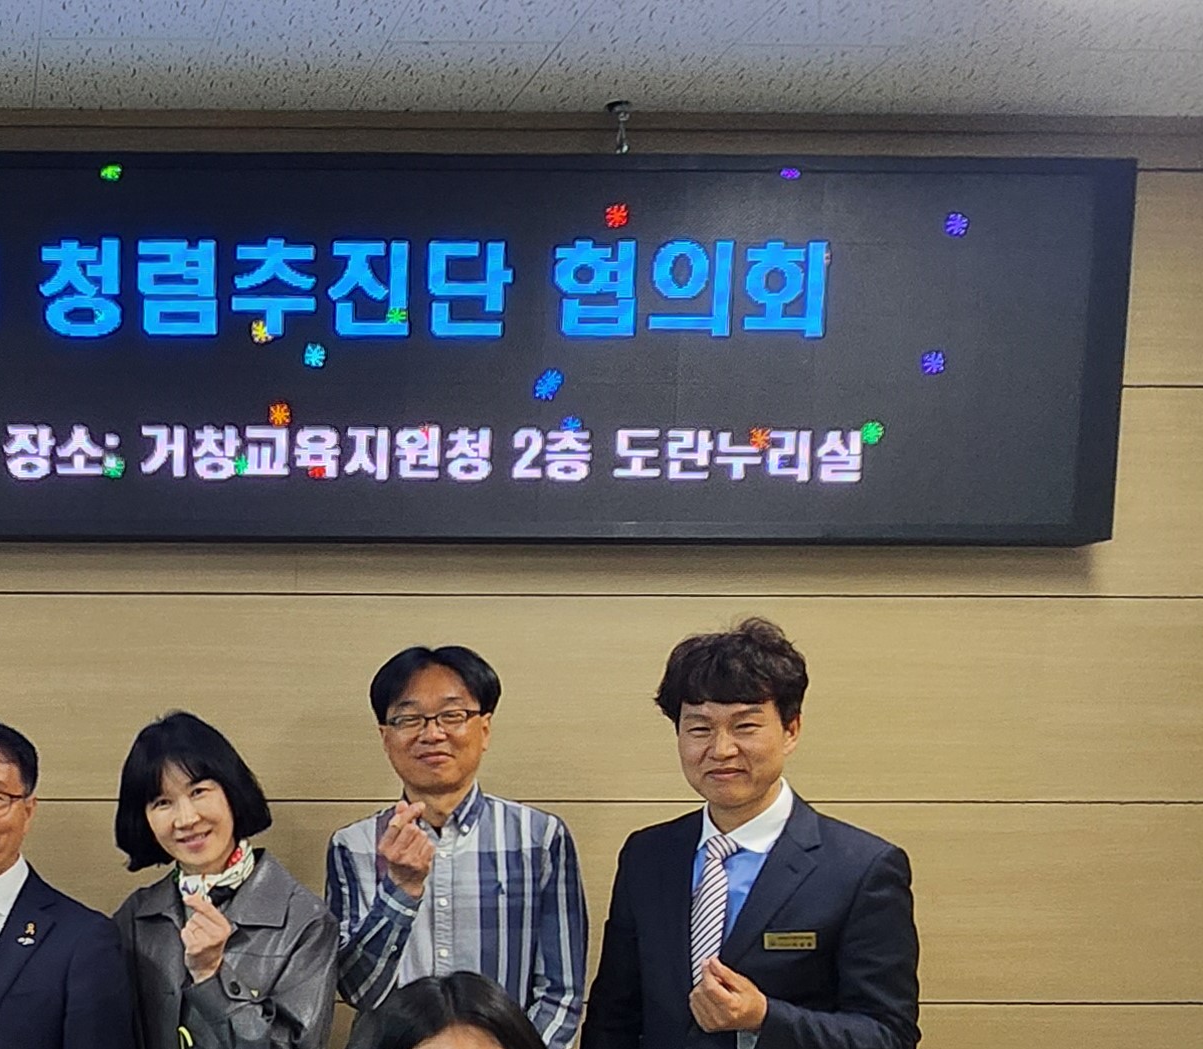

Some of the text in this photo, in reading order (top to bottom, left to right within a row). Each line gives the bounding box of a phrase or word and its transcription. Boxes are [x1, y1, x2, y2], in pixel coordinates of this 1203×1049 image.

[39, 238, 514, 338] 청렴추진단
[555, 238, 832, 338] 협의회
[3, 424, 864, 482] 장소: 거창교육지원청 2층 도란누리실
